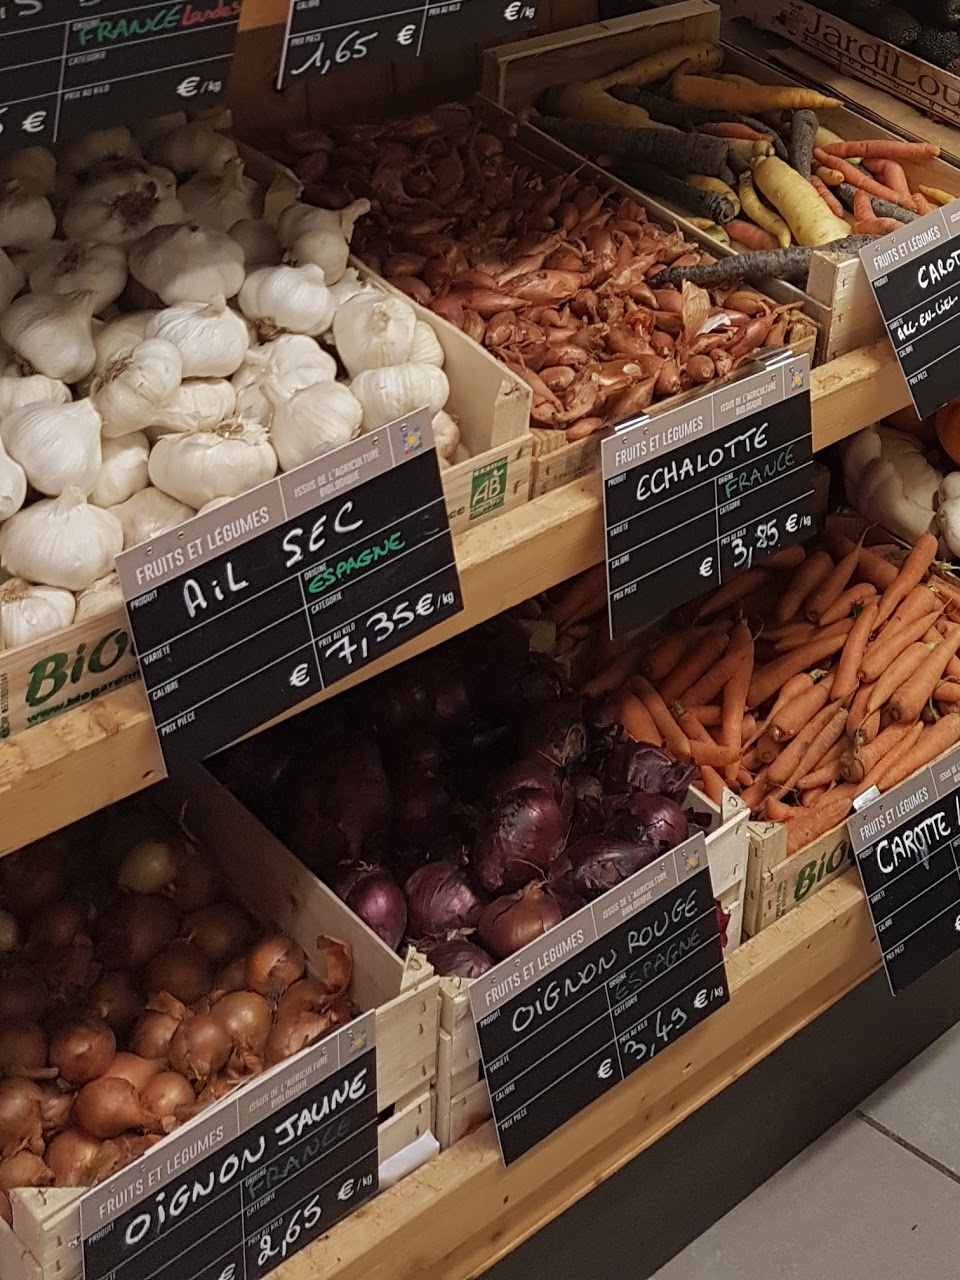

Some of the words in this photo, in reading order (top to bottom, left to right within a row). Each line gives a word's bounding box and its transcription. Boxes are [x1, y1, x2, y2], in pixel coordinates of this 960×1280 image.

[79, 4, 182, 46] FRANCE
[182, 0, 240, 26] Landes
[290, 30, 378, 74] 1,65
[397, 24, 416, 44] €
[873, 247, 899, 271] FRUITS
[908, 225, 941, 252] LÉGUMES
[615, 440, 647, 466] FRUITS
[650, 436, 663, 450] ET
[663, 416, 703, 445] LÉGUMES
[636, 422, 768, 501] ECHALOTTE
[473, 477, 500, 506] AB
[724, 445, 795, 499] FRANCE
[136, 549, 184, 585] FRUITS
[187, 540, 204, 559] ET
[206, 506, 270, 551] LÉGUMES
[282, 501, 363, 569] SEC
[308, 532, 405, 594] ESPAGNE
[130, 589, 158, 611] PRODUIT
[319, 635, 333, 648] PRIX
[324, 601, 416, 665] 7,35
[152, 681, 179, 700] CALIBRE
[289, 663, 310, 688] €
[161, 721, 178, 736] PRIX
[860, 815, 886, 841] FRUITS
[887, 810, 897, 823] ET
[876, 811, 951, 874] CAROTTE
[628, 889, 698, 954] ROUGE
[485, 975, 521, 1006] FRUITS
[524, 966, 536, 984] ET
[615, 930, 700, 999] ESPAGNE
[480, 1009, 501, 1029] PRODUIT
[624, 1007, 688, 1061] 3,49
[597, 1058, 613, 1079] €
[274, 1068, 368, 1146] JAUNE
[249, 1122, 350, 1200] FRANCE
[99, 1182, 144, 1220] FRUITS
[148, 1170, 163, 1188] ET
[88, 1222, 115, 1246] PRODUIT
[257, 1194, 322, 1266] 2,65
